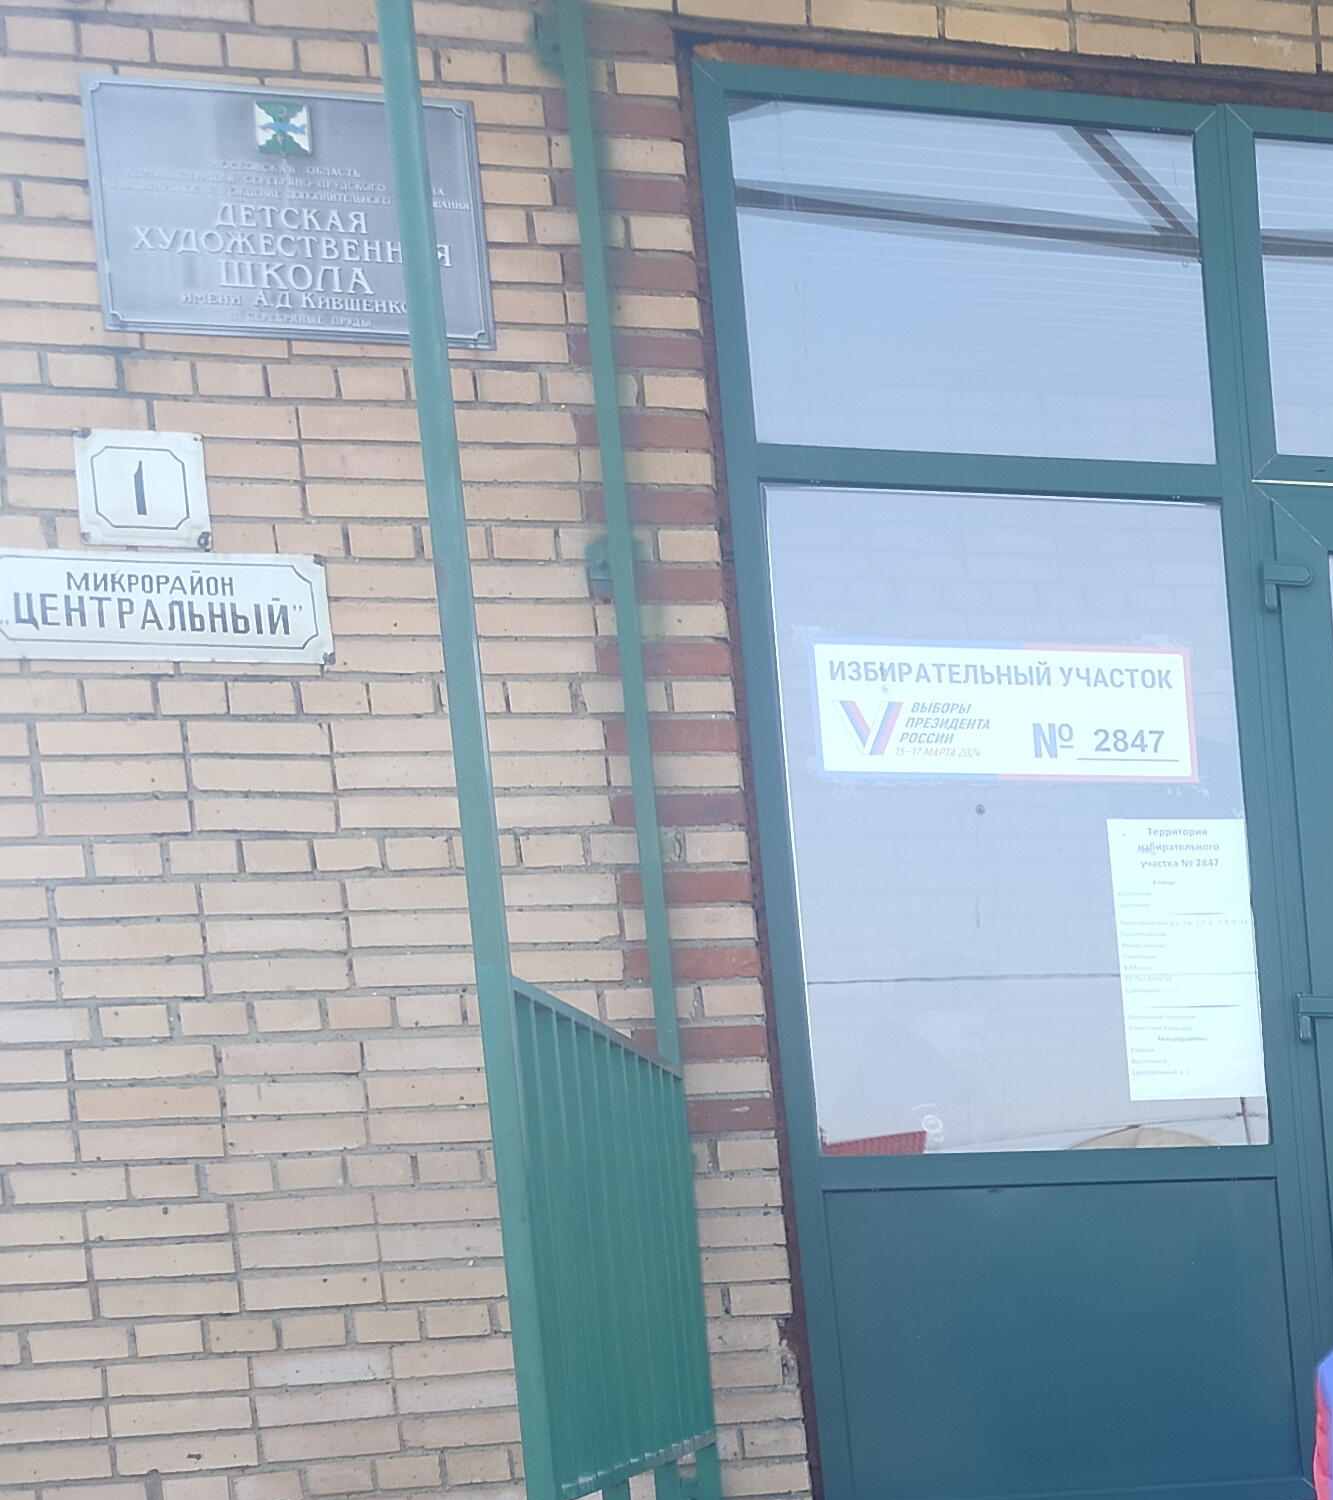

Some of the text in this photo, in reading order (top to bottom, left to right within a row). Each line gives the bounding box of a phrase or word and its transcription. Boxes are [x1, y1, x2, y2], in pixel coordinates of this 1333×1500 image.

[213, 202, 369, 236] ДЕТСКАЯ
[132, 224, 453, 269] ХУДОЖЕСТВЕННЯ
[218, 258, 374, 296] ШКОЛА
[182, 291, 242, 306] ИМЕНИ
[133, 459, 148, 516] 1
[66, 569, 234, 597] МИКРОРАЙОН
[828, 660, 1173, 690] ИЗБИРАТЕЛЬНЫЙ УЧАСТОК
[911, 702, 971, 715] ВЫБОРЫ
[905, 717, 990, 731] ПРЕЗИДЕНТА
[899, 731, 954, 745] РОССИИ
[1092, 728, 1166, 754] 2847
[923, 747, 957, 758] МАРТА
[958, 748, 981, 759] 2024
[1147, 827, 1208, 838] Территория
[1137, 842, 1220, 853] избирательного
[1140, 860, 1179, 869] участка
[1196, 858, 1219, 867] 2847
